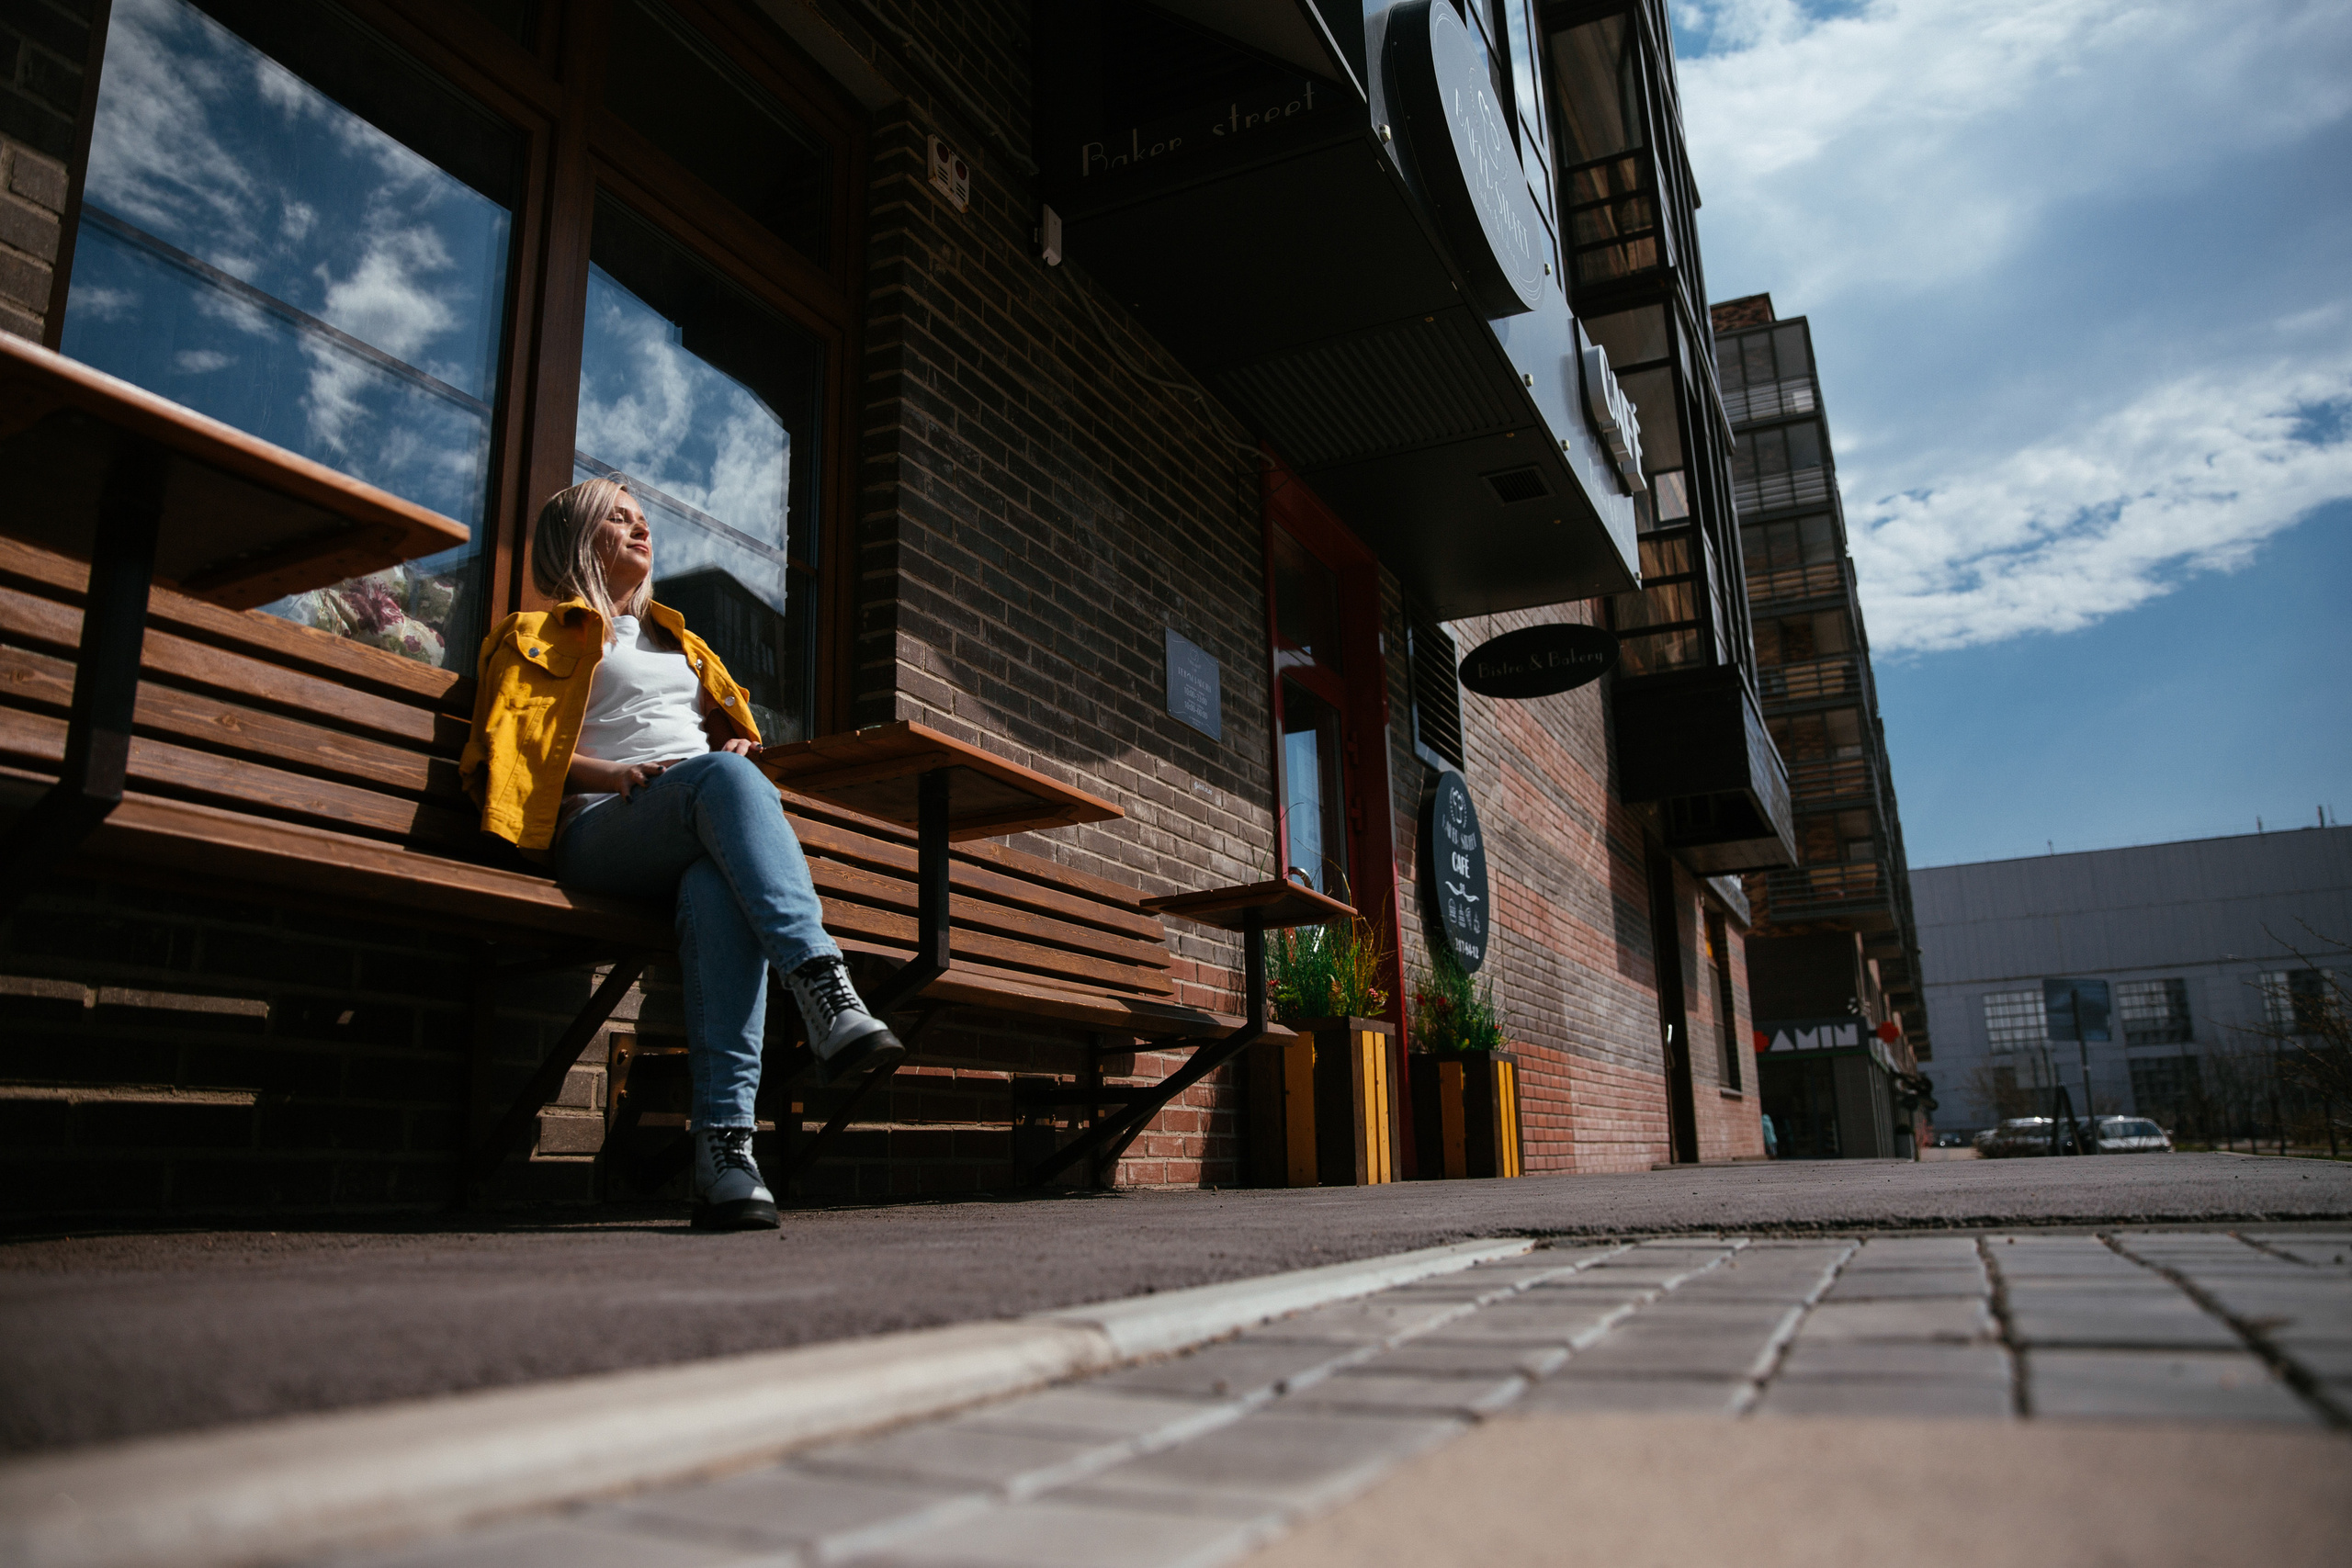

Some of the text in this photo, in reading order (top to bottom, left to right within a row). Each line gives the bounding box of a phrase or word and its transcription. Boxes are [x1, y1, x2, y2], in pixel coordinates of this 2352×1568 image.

[1082, 80, 1315, 177] Baker street
[1477, 647, 1603, 680] Bistro & Bakery
[1451, 851, 1471, 879] CAFÉ
